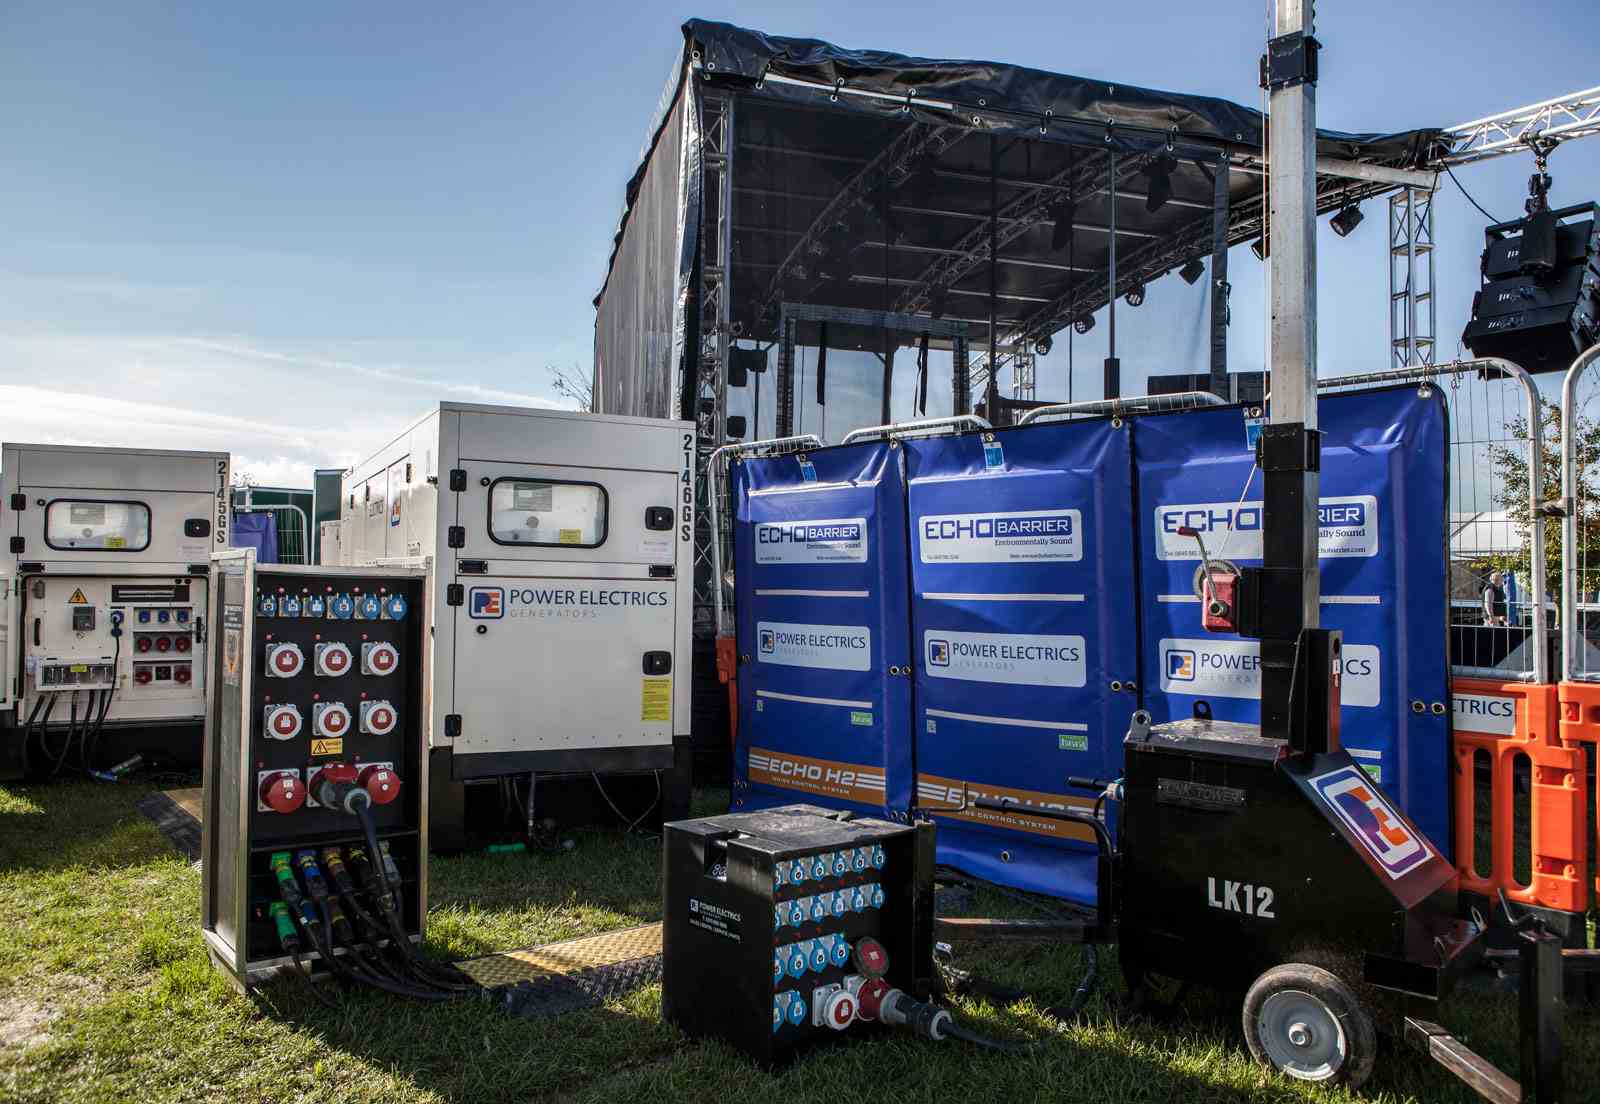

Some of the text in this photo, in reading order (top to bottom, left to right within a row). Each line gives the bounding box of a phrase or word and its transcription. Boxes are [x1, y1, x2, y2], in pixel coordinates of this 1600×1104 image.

[682, 434, 693, 542] 2146GS
[217, 461, 227, 544] 2145GS
[1163, 507, 1361, 533] ECHO RIER
[759, 526, 858, 544] ECHO BARRIER
[924, 519, 1069, 540] ECHO BARRIER
[1336, 528, 1366, 538] Sound
[1049, 537, 1073, 546] Sound
[509, 589, 668, 606] POWER ELECTRICS
[510, 608, 598, 618] GENERATORS
[776, 632, 867, 649] POWER ELECTRICS
[952, 642, 1080, 662] POWER ELECTRICS
[1200, 653, 1262, 671] POWER
[768, 758, 856, 787] ECHO H2
[977, 810, 1017, 825] CONTROL
[1207, 876, 1275, 919] LK12
